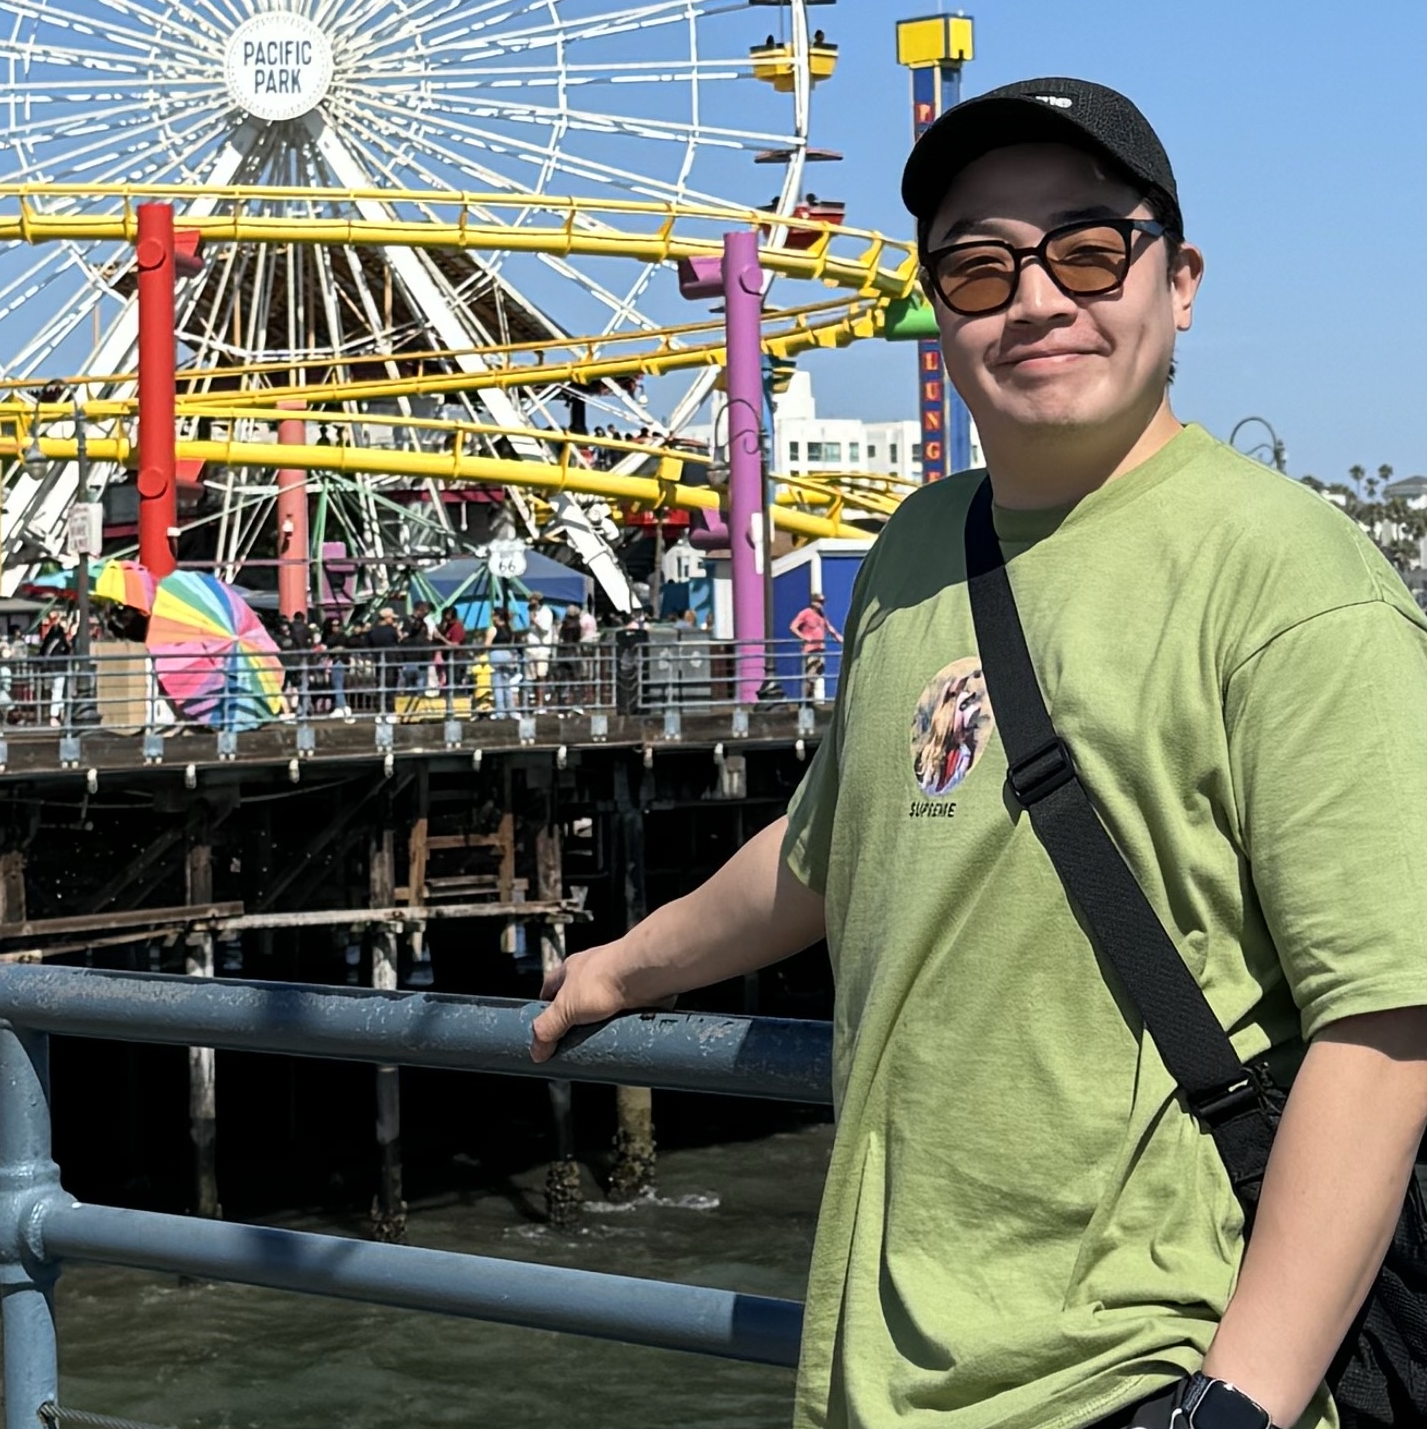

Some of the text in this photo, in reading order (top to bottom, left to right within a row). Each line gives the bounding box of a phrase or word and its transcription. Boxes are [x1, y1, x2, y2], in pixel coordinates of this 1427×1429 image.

[243, 40, 312, 66] PACIFIC
[254, 69, 302, 94] PARK
[498, 561, 516, 573] 66
